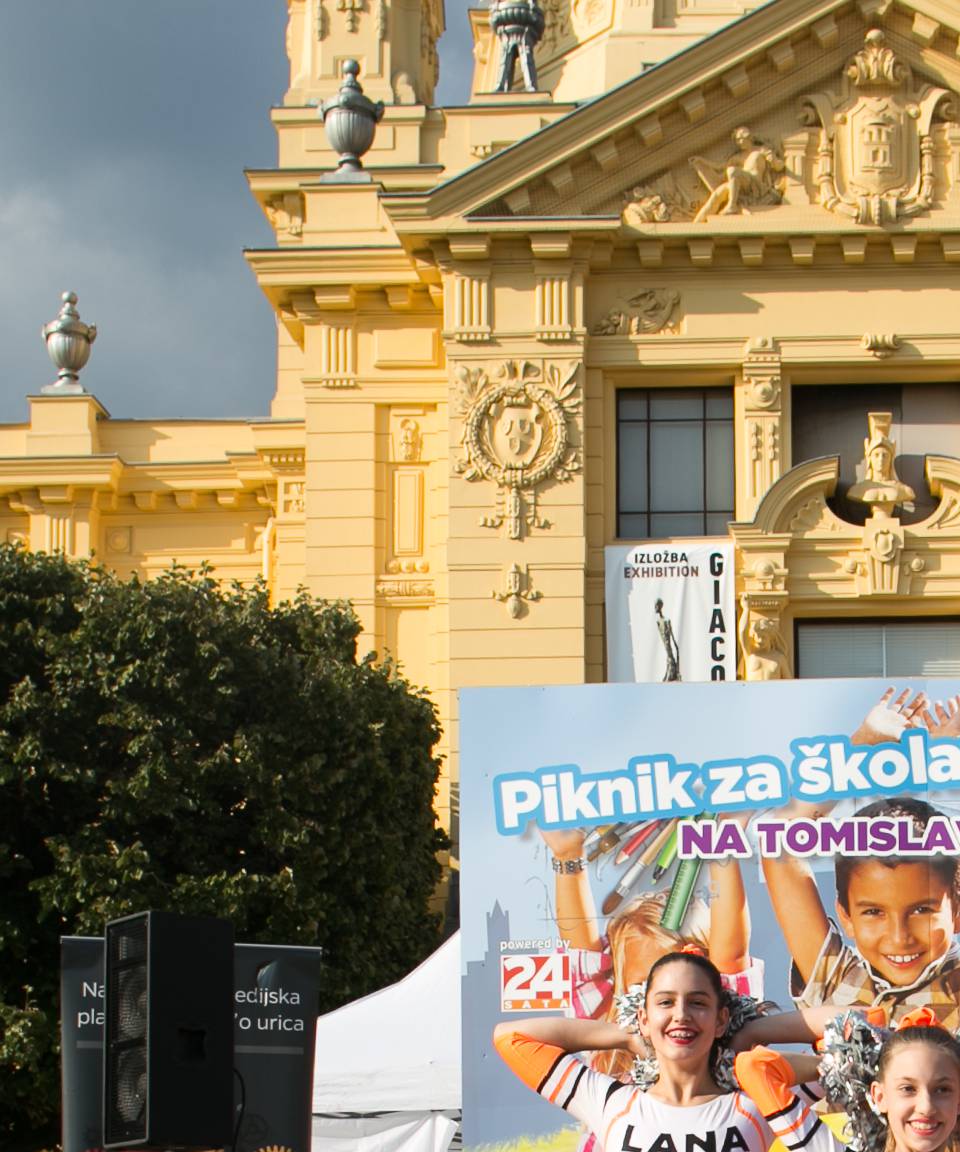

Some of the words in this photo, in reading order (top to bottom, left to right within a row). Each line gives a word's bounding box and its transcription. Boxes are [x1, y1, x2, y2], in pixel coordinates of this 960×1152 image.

[634, 550, 688, 564] IZLOŽBA
[624, 565, 699, 579] EXHIBITION
[502, 760, 694, 828] Piknik
[704, 762, 783, 804] za
[682, 823, 749, 856] NA
[500, 938, 552, 952] powered
[556, 939, 570, 950] by
[503, 955, 571, 999] 24
[257, 1014, 304, 1031] urica
